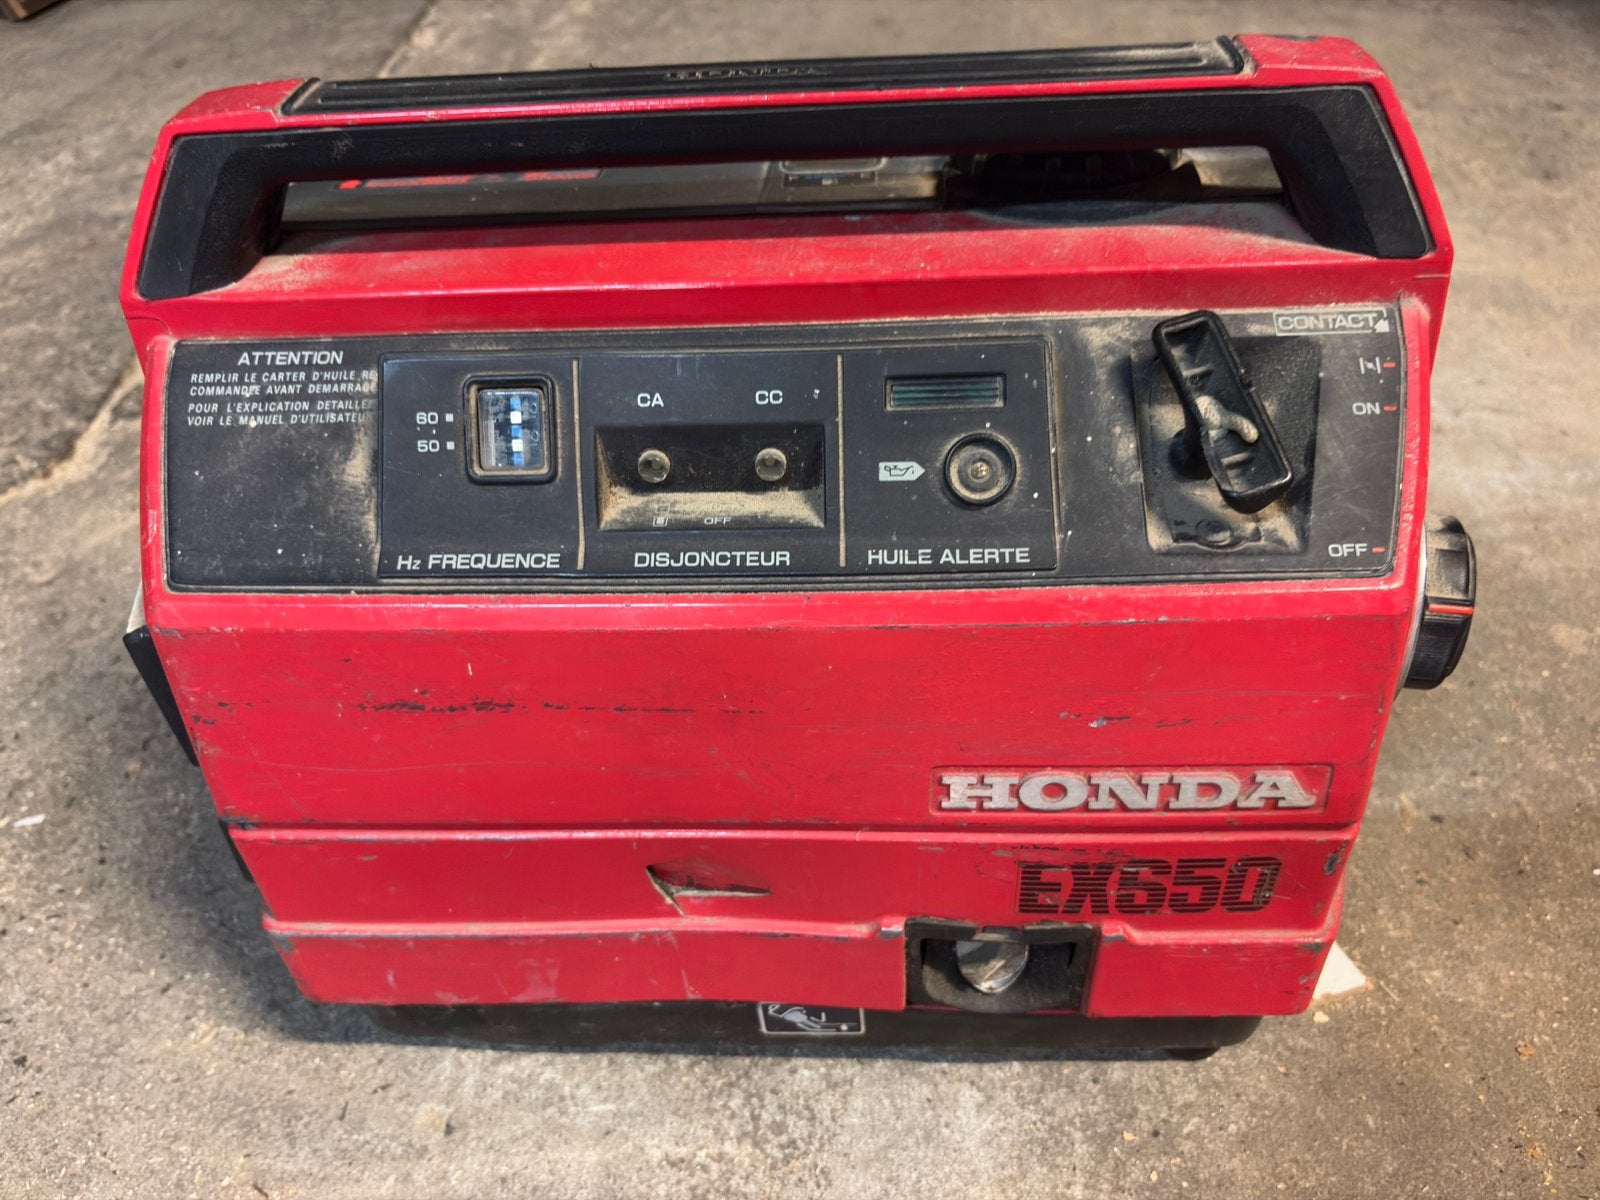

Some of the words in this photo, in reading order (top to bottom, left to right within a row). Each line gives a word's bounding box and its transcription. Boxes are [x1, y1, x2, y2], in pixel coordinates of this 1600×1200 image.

[1278, 313, 1377, 331] CONTACT
[238, 351, 343, 365] ATTENTION
[191, 373, 239, 383] REMPLIR
[244, 372, 257, 382] LE
[262, 371, 306, 382] CARTER
[312, 370, 356, 381] D'HUILE
[190, 385, 261, 397] COMMANDEE
[266, 384, 302, 395] AVANT
[637, 394, 664, 408] CA
[755, 391, 783, 405] CC
[188, 403, 218, 414] POUR
[227, 401, 310, 413] L'EXPLICATION
[1352, 402, 1380, 415] ON
[187, 416, 213, 426] VOIR
[219, 415, 232, 425] LE
[238, 414, 284, 425] MANUEL
[416, 412, 439, 425] 60
[417, 440, 440, 453] 50
[704, 517, 732, 525] OFF
[867, 549, 932, 565] HUILE
[939, 547, 1030, 564] ALERTE
[1328, 543, 1368, 557] OFF
[397, 556, 421, 571] Hz
[428, 553, 561, 570] FREQUENCE
[634, 551, 791, 568] DISJONCTEUR
[940, 770, 1316, 811] HONDA
[1017, 856, 1282, 914] EX650
